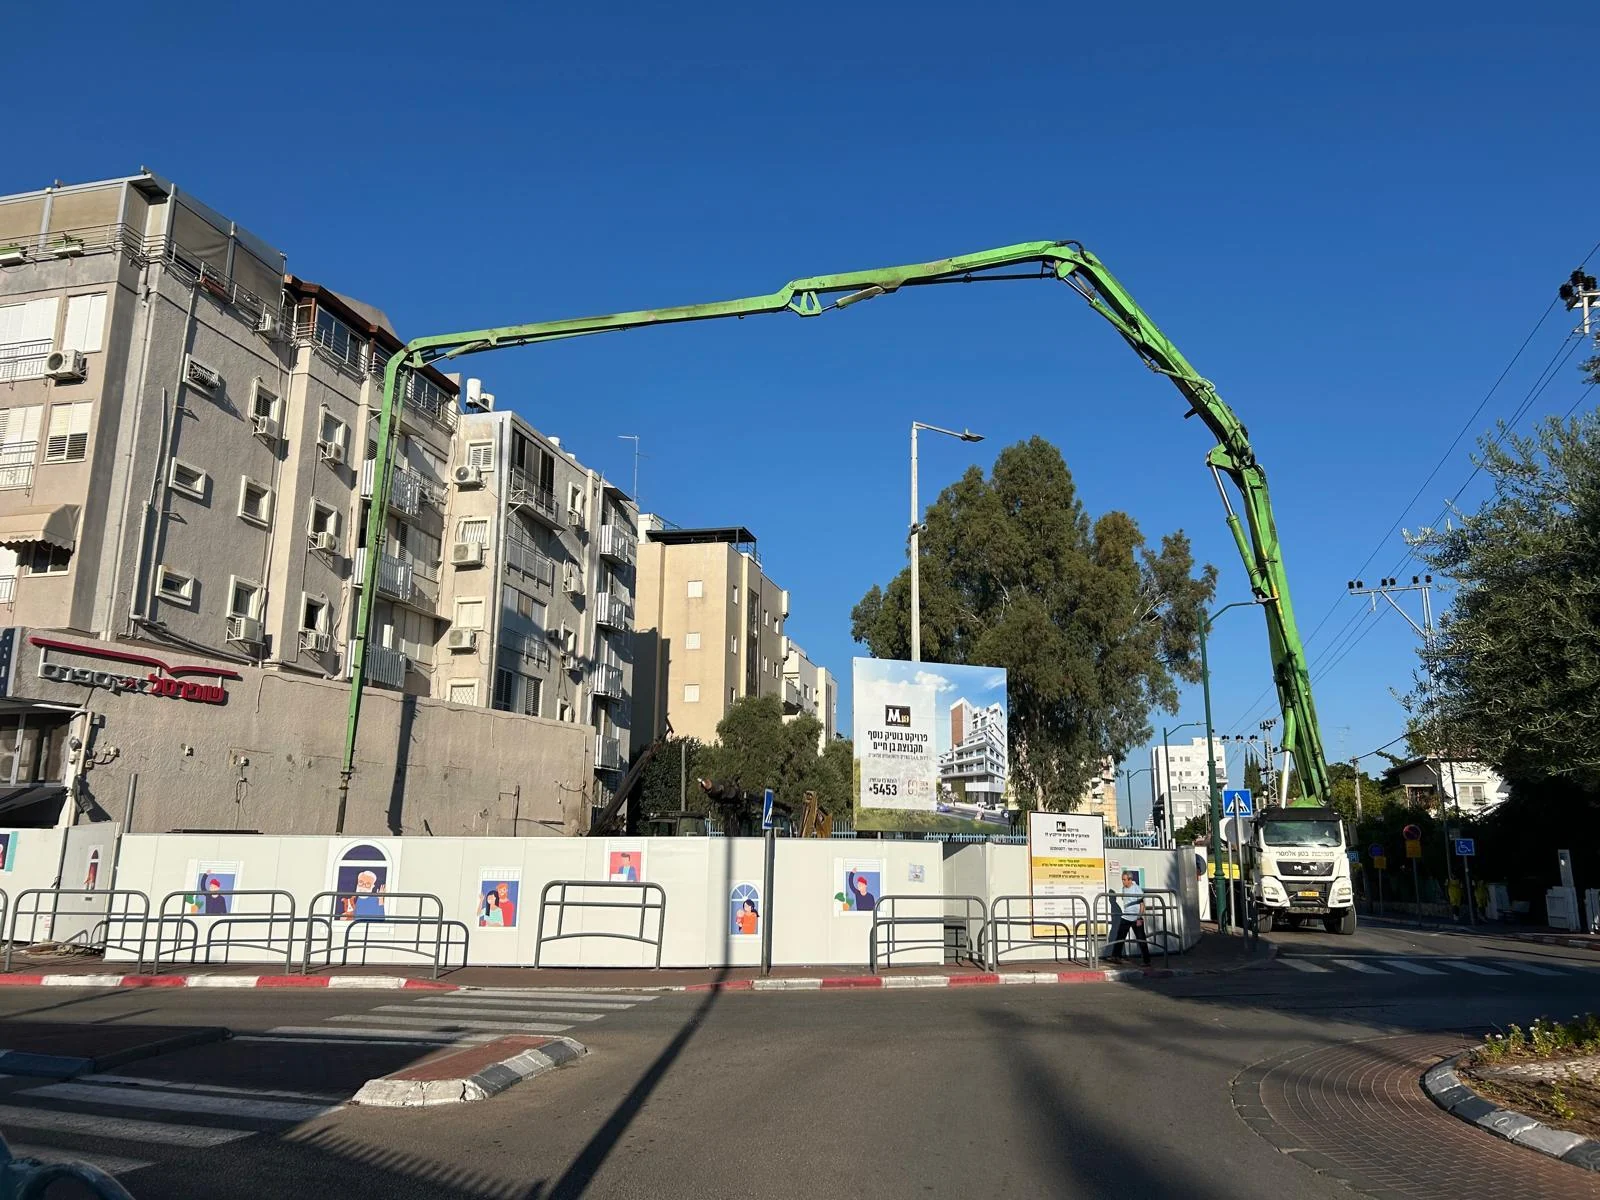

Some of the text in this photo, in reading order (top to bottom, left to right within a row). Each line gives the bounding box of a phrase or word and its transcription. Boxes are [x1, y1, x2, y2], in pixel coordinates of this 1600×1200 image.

[148, 673, 224, 703] שופרסל
[868, 731, 928, 742] פרויקט בוטיק נוסף
[873, 742, 923, 754] מקבוצת בן חיים
